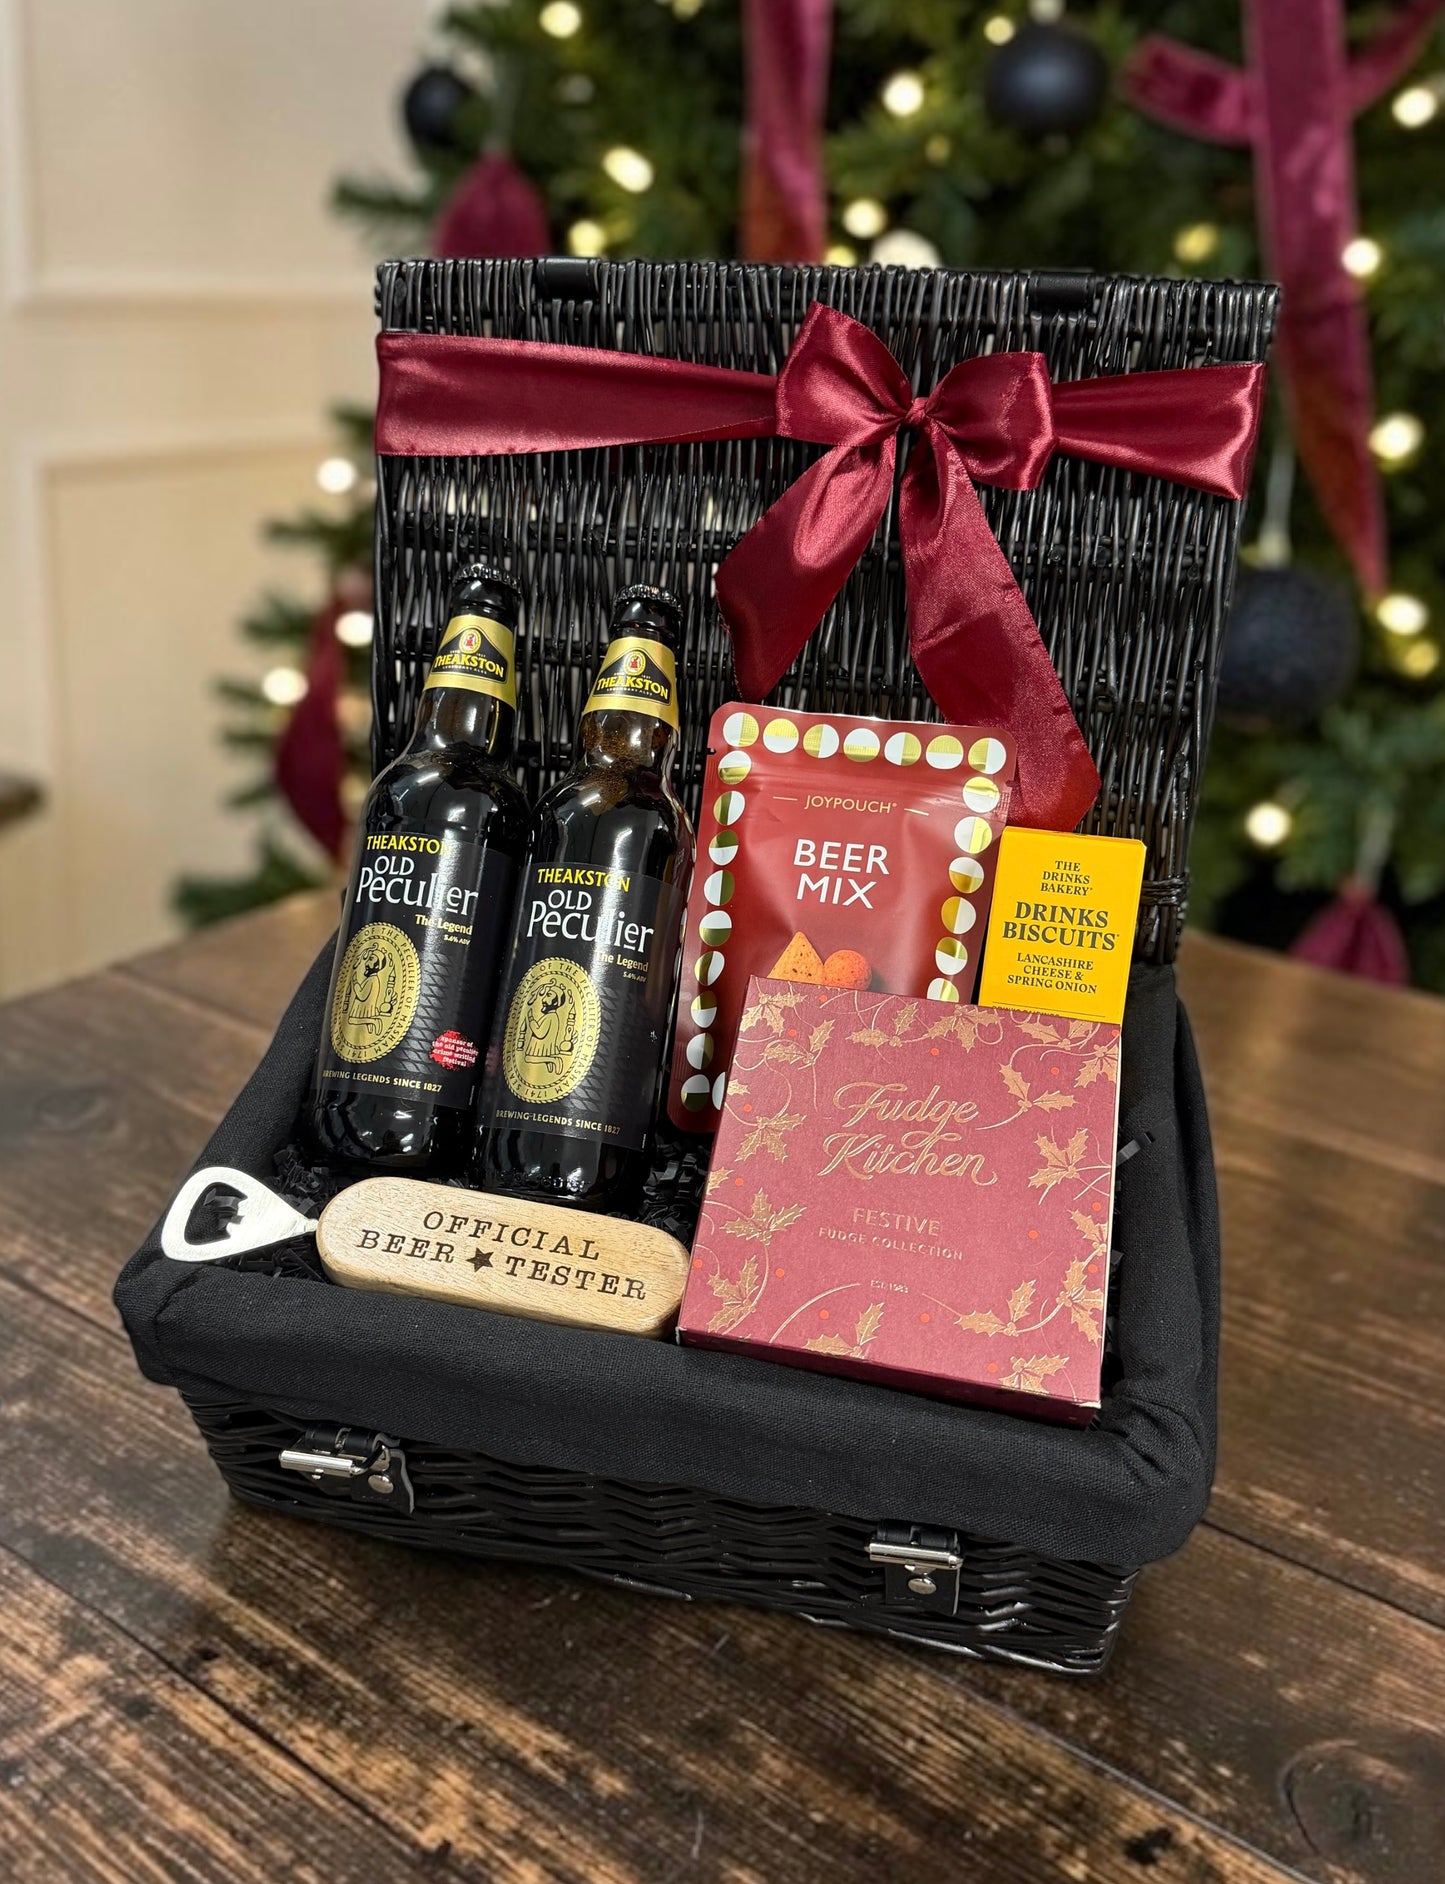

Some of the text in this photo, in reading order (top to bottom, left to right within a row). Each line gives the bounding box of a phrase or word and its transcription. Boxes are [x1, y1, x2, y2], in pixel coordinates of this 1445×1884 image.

[434, 653, 504, 678] THEAKSTON
[597, 676, 668, 700] THEAKSTON
[804, 794, 892, 814] JOYPOUCH
[374, 855, 415, 876] OLD
[793, 838, 890, 875] BEER
[1055, 860, 1081, 872] THE
[537, 868, 631, 893] THEAKSTON
[1040, 882, 1089, 896] BAKERY
[1042, 871, 1090, 885] DRINKS
[548, 889, 592, 911] OLD
[796, 873, 877, 909] MIX
[415, 914, 473, 936] The Legend
[526, 900, 655, 953] Peculier
[1015, 901, 1109, 929] DRINKS
[364, 928, 375, 937] OF
[380, 928, 399, 940] THE
[1002, 921, 1116, 951] BISCUITS
[401, 942, 414, 991] PECULIER
[540, 962, 552, 971] OF
[559, 963, 578, 975] THE
[595, 951, 649, 973] The Legend
[1017, 952, 1094, 971] LANCASHIRE
[1023, 965, 1084, 981] CHEESE &
[1007, 975, 1097, 994] SPRING ONION
[407, 996, 413, 1009] OF
[580, 980, 595, 1029] PECULIER
[374, 1015, 407, 1054] MASHAM
[588, 1035, 594, 1049] OF
[346, 1050, 367, 1058] 1741
[323, 1069, 442, 1093] BREWING LEGENDS SINCE 1827
[506, 1066, 522, 1091] SEAL
[556, 1054, 587, 1094] MASHAM
[524, 1089, 547, 1098] 1741
[495, 1110, 621, 1135] BREWING LEGENDS SINCE 1827
[833, 1081, 979, 1149] Fudge
[817, 1132, 998, 1186] Kitchen
[852, 1207, 941, 1237] FESTIVE
[423, 1210, 600, 1260] OFFICIAL
[819, 1227, 963, 1261] FUDGE COLLECTION
[356, 1229, 646, 1300] BEER TESTER
